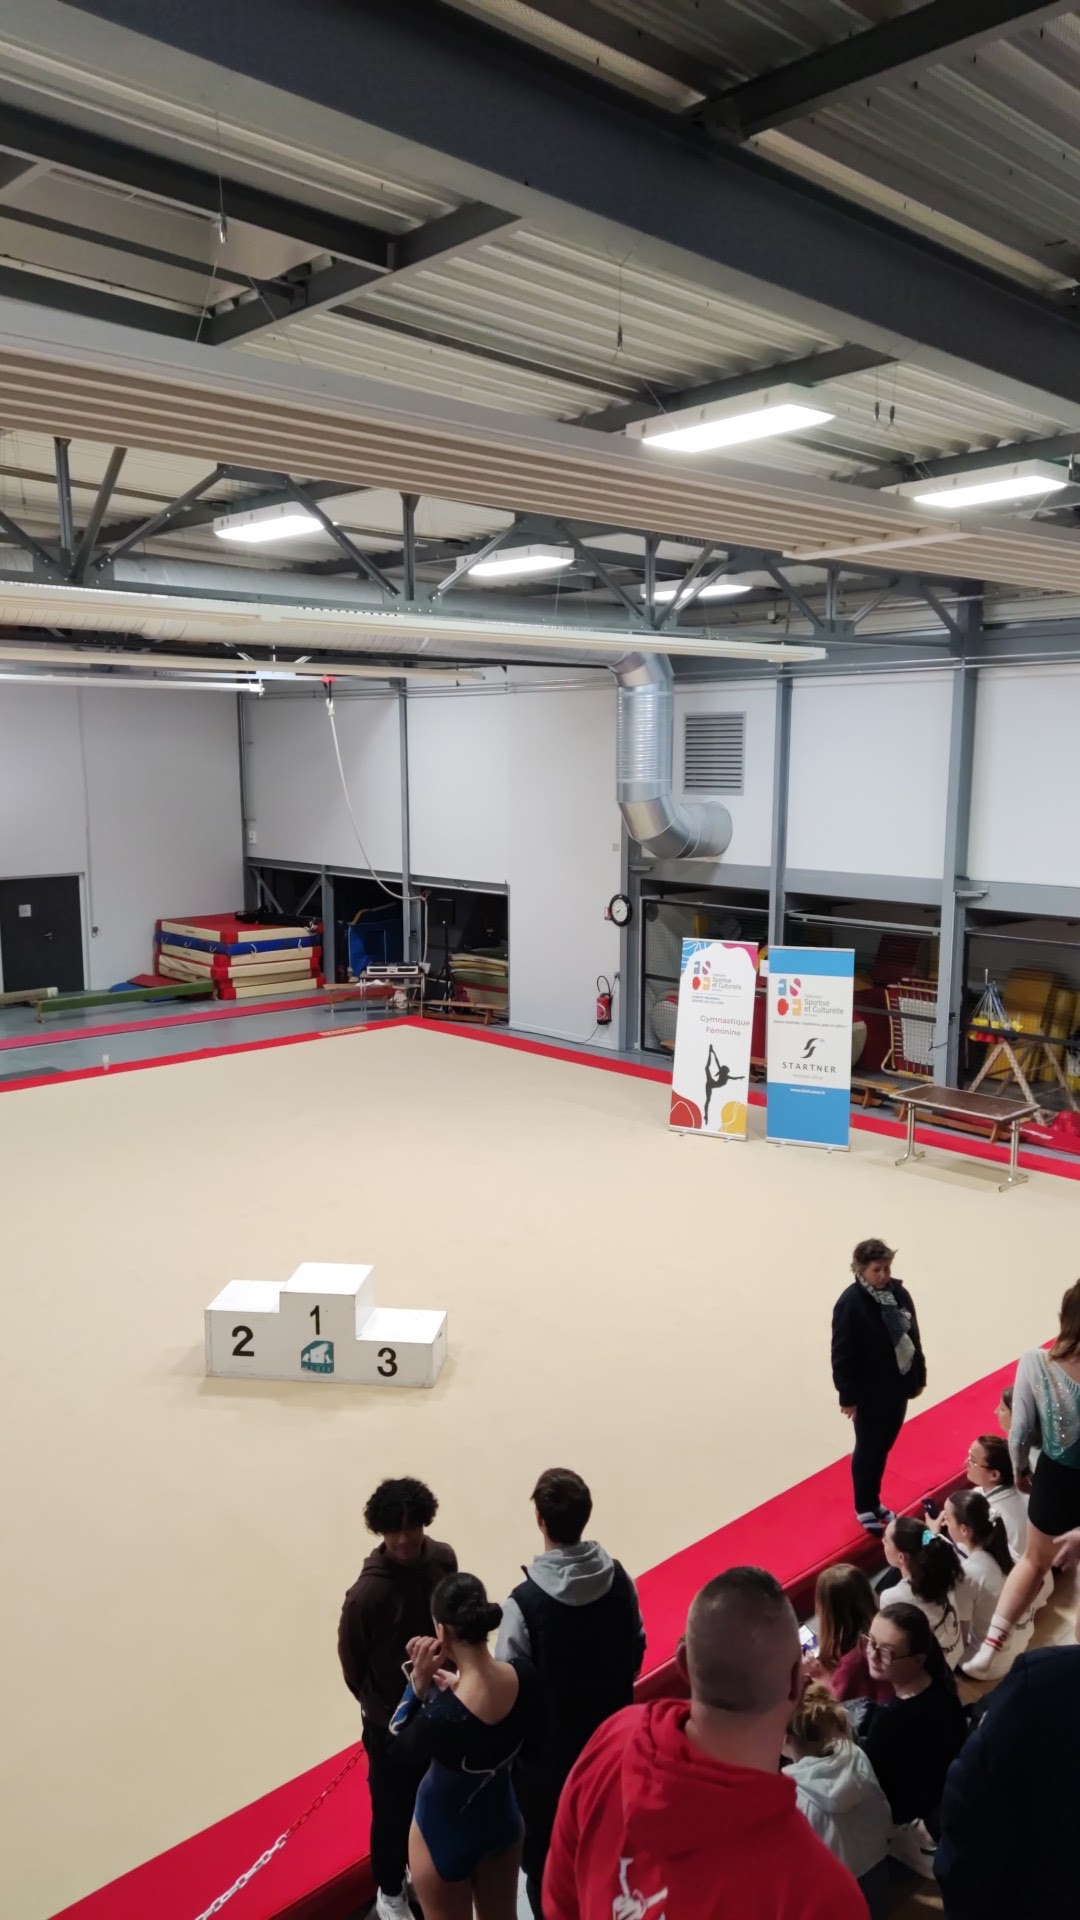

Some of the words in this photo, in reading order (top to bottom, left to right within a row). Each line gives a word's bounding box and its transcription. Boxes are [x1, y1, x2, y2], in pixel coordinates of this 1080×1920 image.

[804, 998, 830, 1008] Sportive
[812, 1005, 844, 1015] Culturelle
[700, 1015, 750, 1027] Gymnastique
[705, 1026, 742, 1037] Féminine
[782, 1061, 836, 1073] STARTNER
[310, 1305, 320, 1335] 1
[231, 1325, 255, 1357] 2
[377, 1347, 398, 1377] 3
